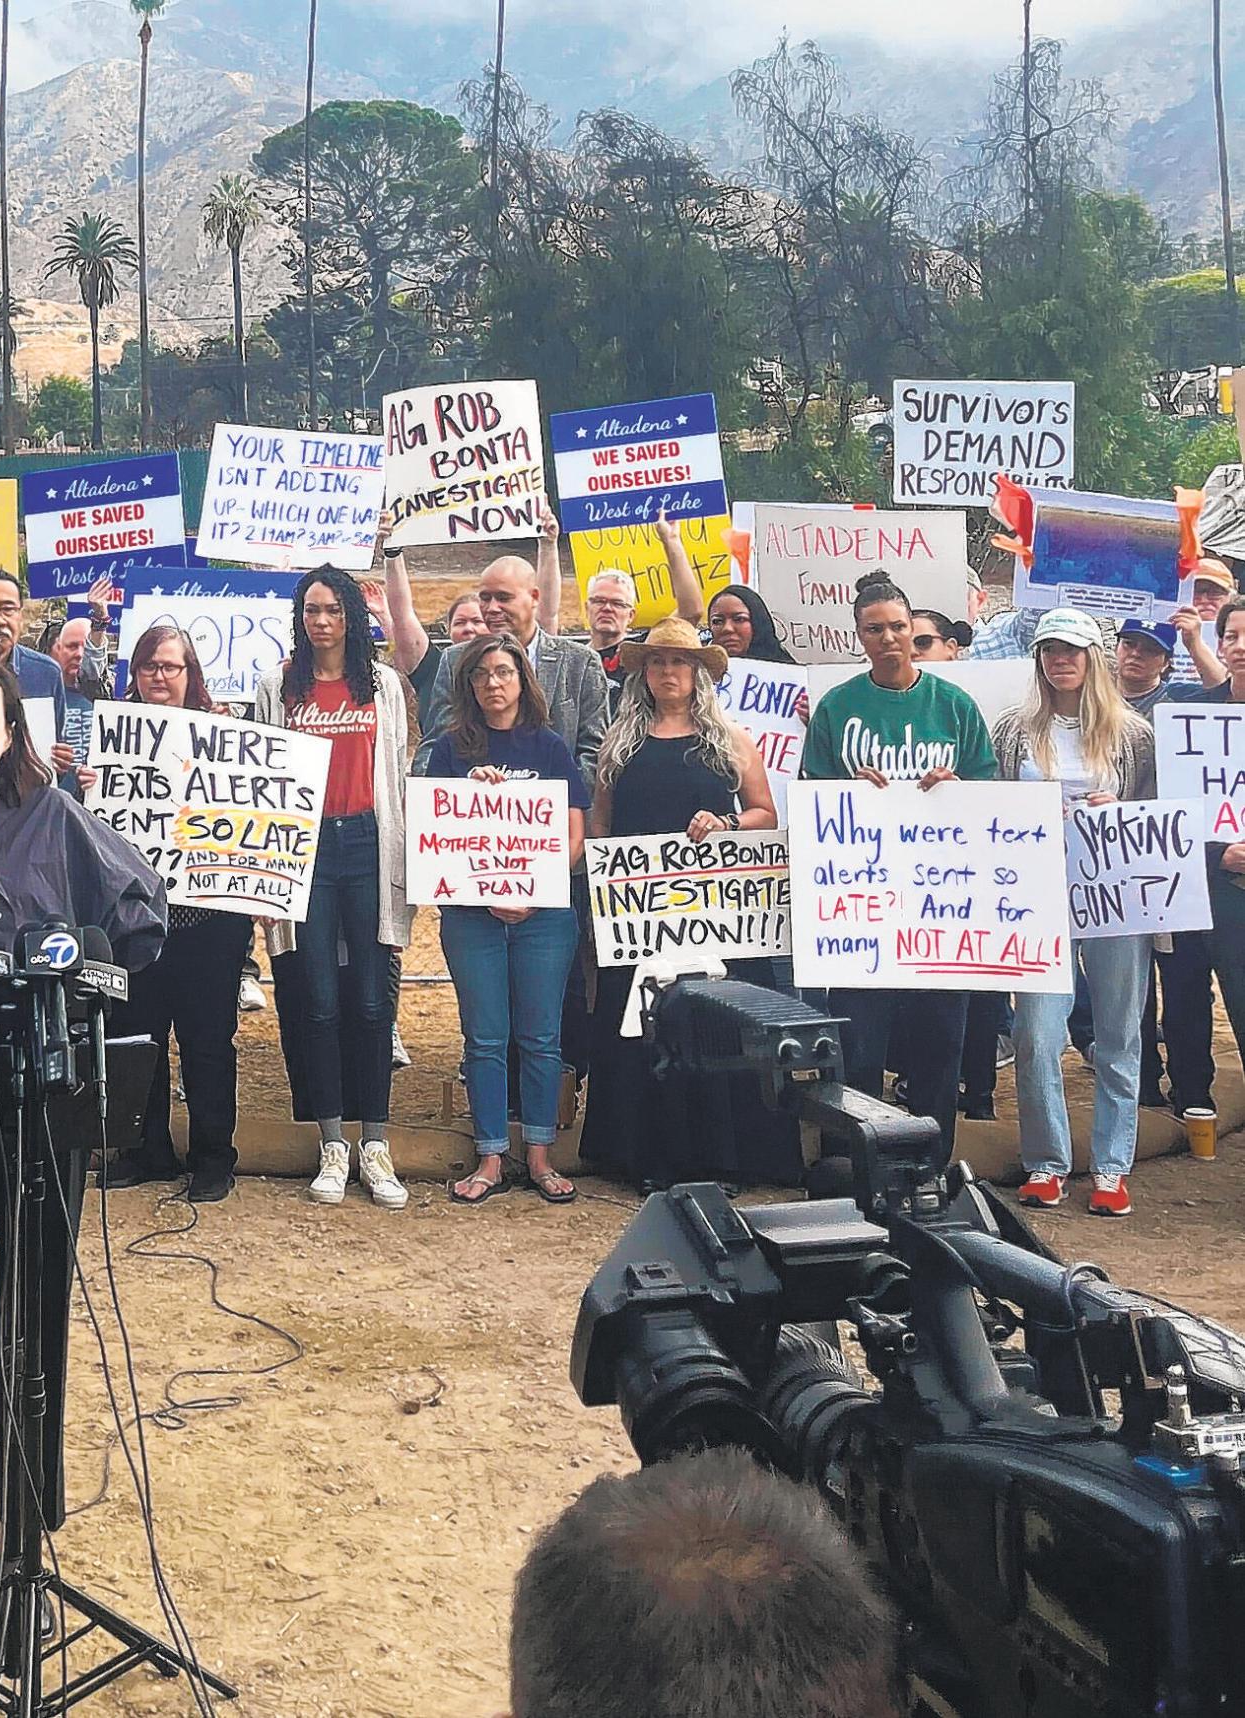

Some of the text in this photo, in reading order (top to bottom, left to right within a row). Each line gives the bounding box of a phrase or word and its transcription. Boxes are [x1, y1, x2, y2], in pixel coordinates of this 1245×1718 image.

[387, 391, 501, 456] AG ROB
[594, 418, 673, 441] Altadena
[227, 434, 385, 468] YOUR TIMELINE
[430, 426, 532, 480] BONTA
[592, 441, 681, 467] WE SAVED
[923, 429, 1066, 469] DEMAND
[64, 475, 139, 501] Altadena
[275, 469, 362, 496] ADDING
[588, 465, 691, 492] OURSELVES!
[389, 466, 543, 526] INVESTIGATE
[585, 491, 702, 522] West of Lake
[61, 503, 145, 529] WE SAVED
[250, 500, 310, 523] WHICH
[317, 505, 349, 525] ONE
[352, 507, 378, 525] WAS
[448, 499, 543, 538] NOW!
[55, 528, 154, 556] OURSELVES!
[211, 522, 241, 540] IT?
[766, 522, 935, 561] ALTADENA
[53, 566, 95, 588] West
[205, 671, 245, 693] rystal
[292, 700, 376, 726] Altadena
[98, 714, 168, 762] WHY
[189, 721, 287, 770] WERE
[841, 716, 957, 780] Altadena
[1171, 715, 1242, 756] IT
[93, 763, 315, 812] TEXTS ALERTS
[434, 788, 553, 826] BLAMING
[186, 815, 233, 842] SO
[240, 818, 313, 857] LATE
[815, 790, 1047, 864] Why were text
[419, 832, 562, 855] MOTHER NATURE
[609, 840, 789, 877] AG ROB BONTA
[186, 851, 307, 877] AND FOR MANY
[469, 855, 536, 872] IS NOT
[813, 859, 1018, 886] alerts sent so
[188, 872, 293, 904] NOT AT ALL!
[434, 877, 534, 898] A PLAN
[596, 877, 790, 917] INVESTIGATE
[818, 890, 1035, 922] LATE?! And for
[817, 927, 1063, 975] many NOT AT ALL!
